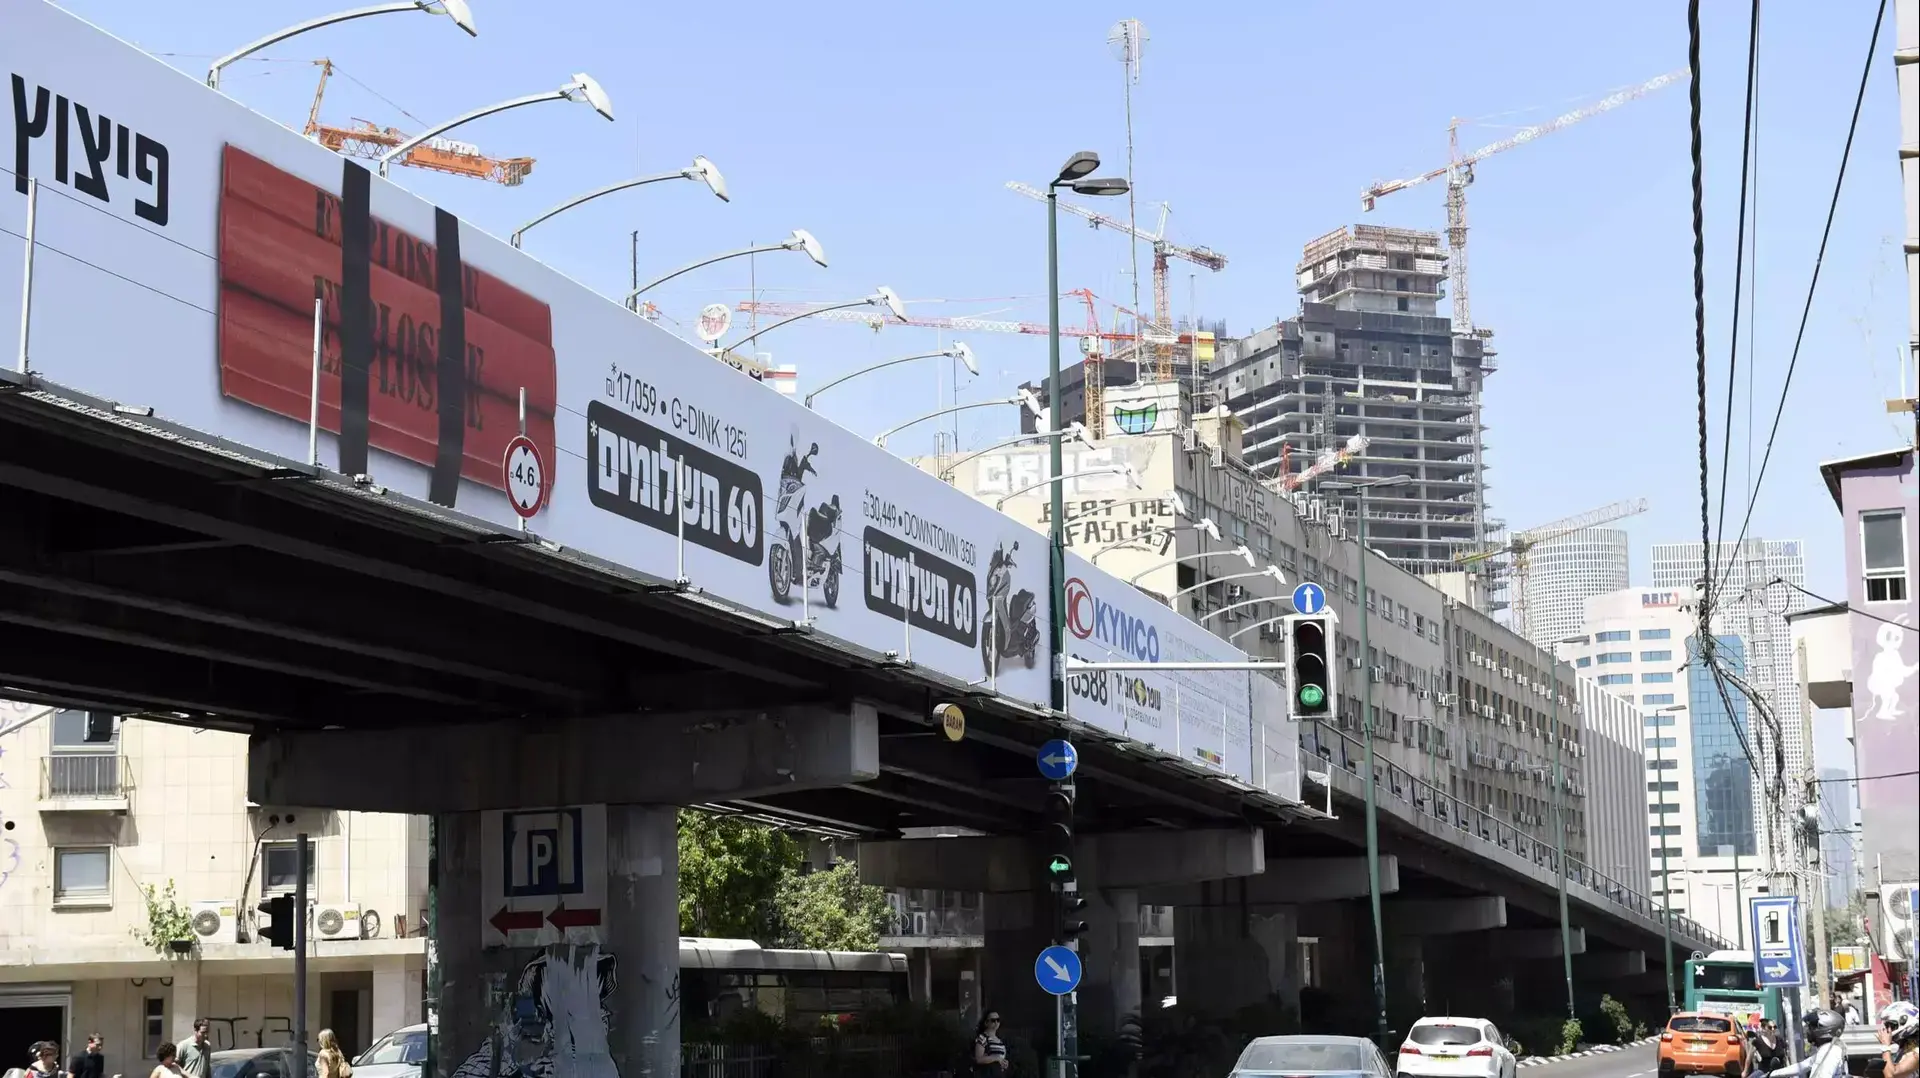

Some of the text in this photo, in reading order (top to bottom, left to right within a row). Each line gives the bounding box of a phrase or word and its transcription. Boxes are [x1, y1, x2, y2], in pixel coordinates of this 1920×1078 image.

[11, 72, 169, 227] פיצוץ
[671, 397, 720, 448] G-DINK
[724, 423, 747, 460] 125i
[515, 462, 535, 487] 4.6
[727, 485, 757, 548] 60
[1130, 497, 1174, 518] THE
[904, 511, 958, 562] DOWNTOWN
[960, 539, 977, 568] 350i
[953, 584, 973, 634] 60
[1095, 597, 1159, 663] KYMCO
